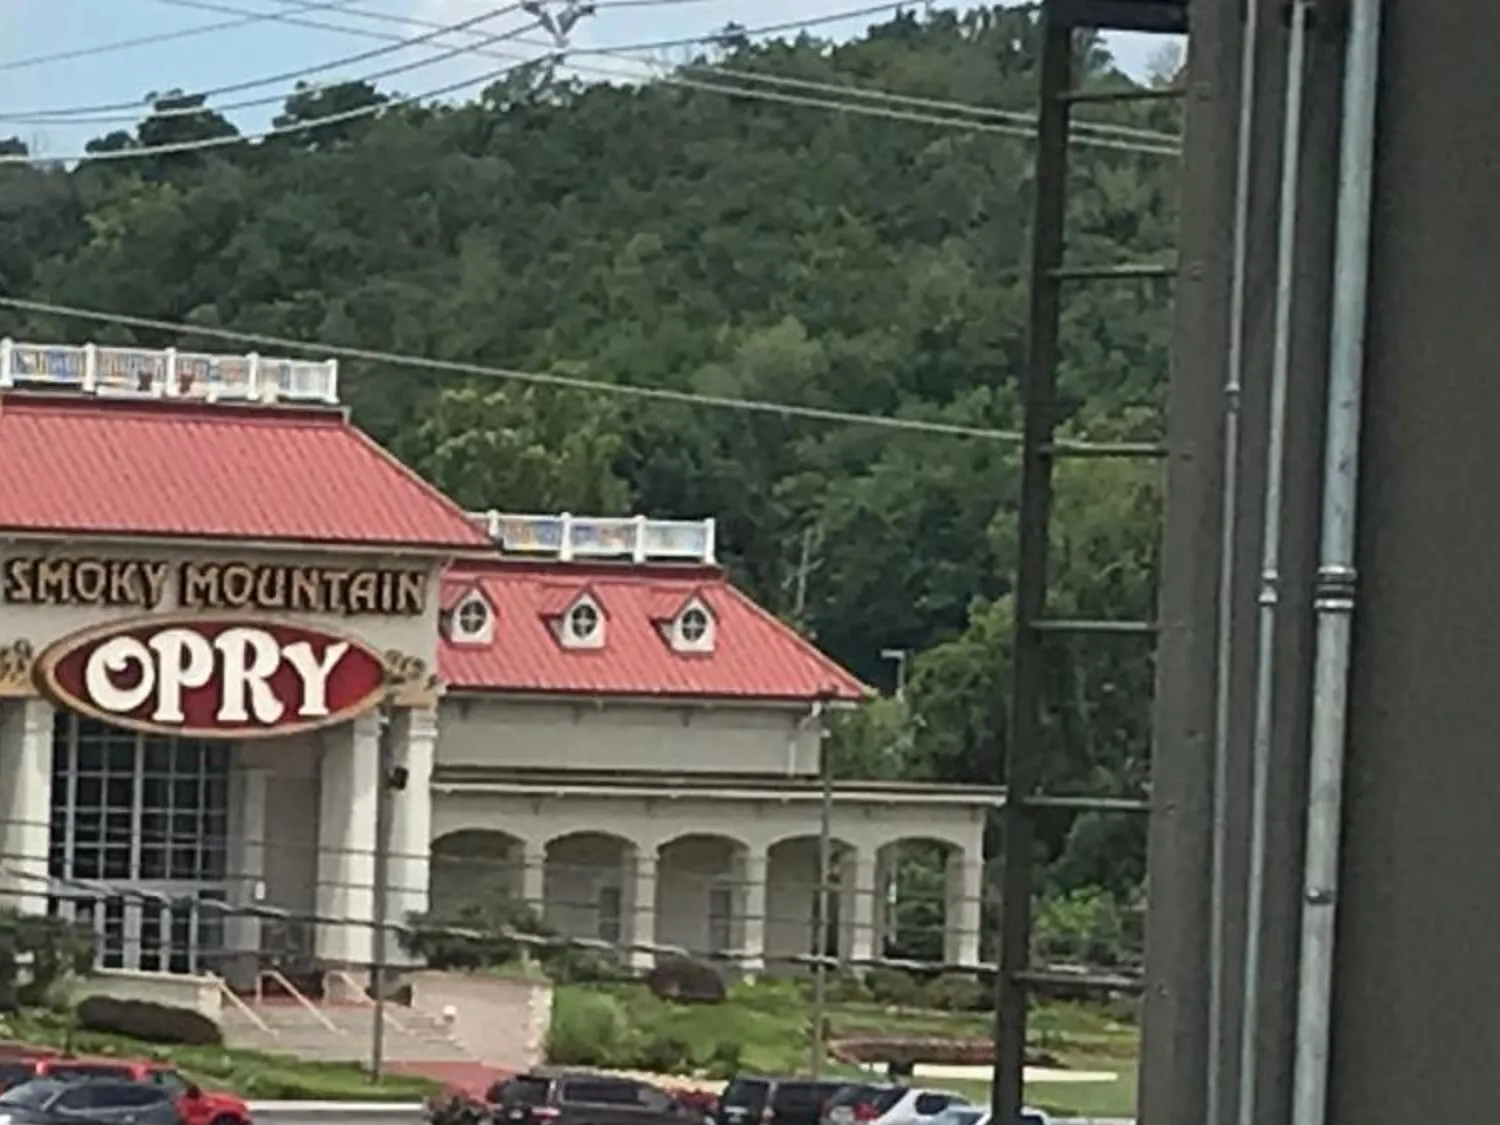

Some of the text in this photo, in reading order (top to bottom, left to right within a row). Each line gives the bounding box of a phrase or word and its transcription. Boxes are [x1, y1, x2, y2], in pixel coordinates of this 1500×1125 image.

[5, 556, 426, 615] SMOKY MOUNTAIN
[85, 627, 349, 724] OPRY
